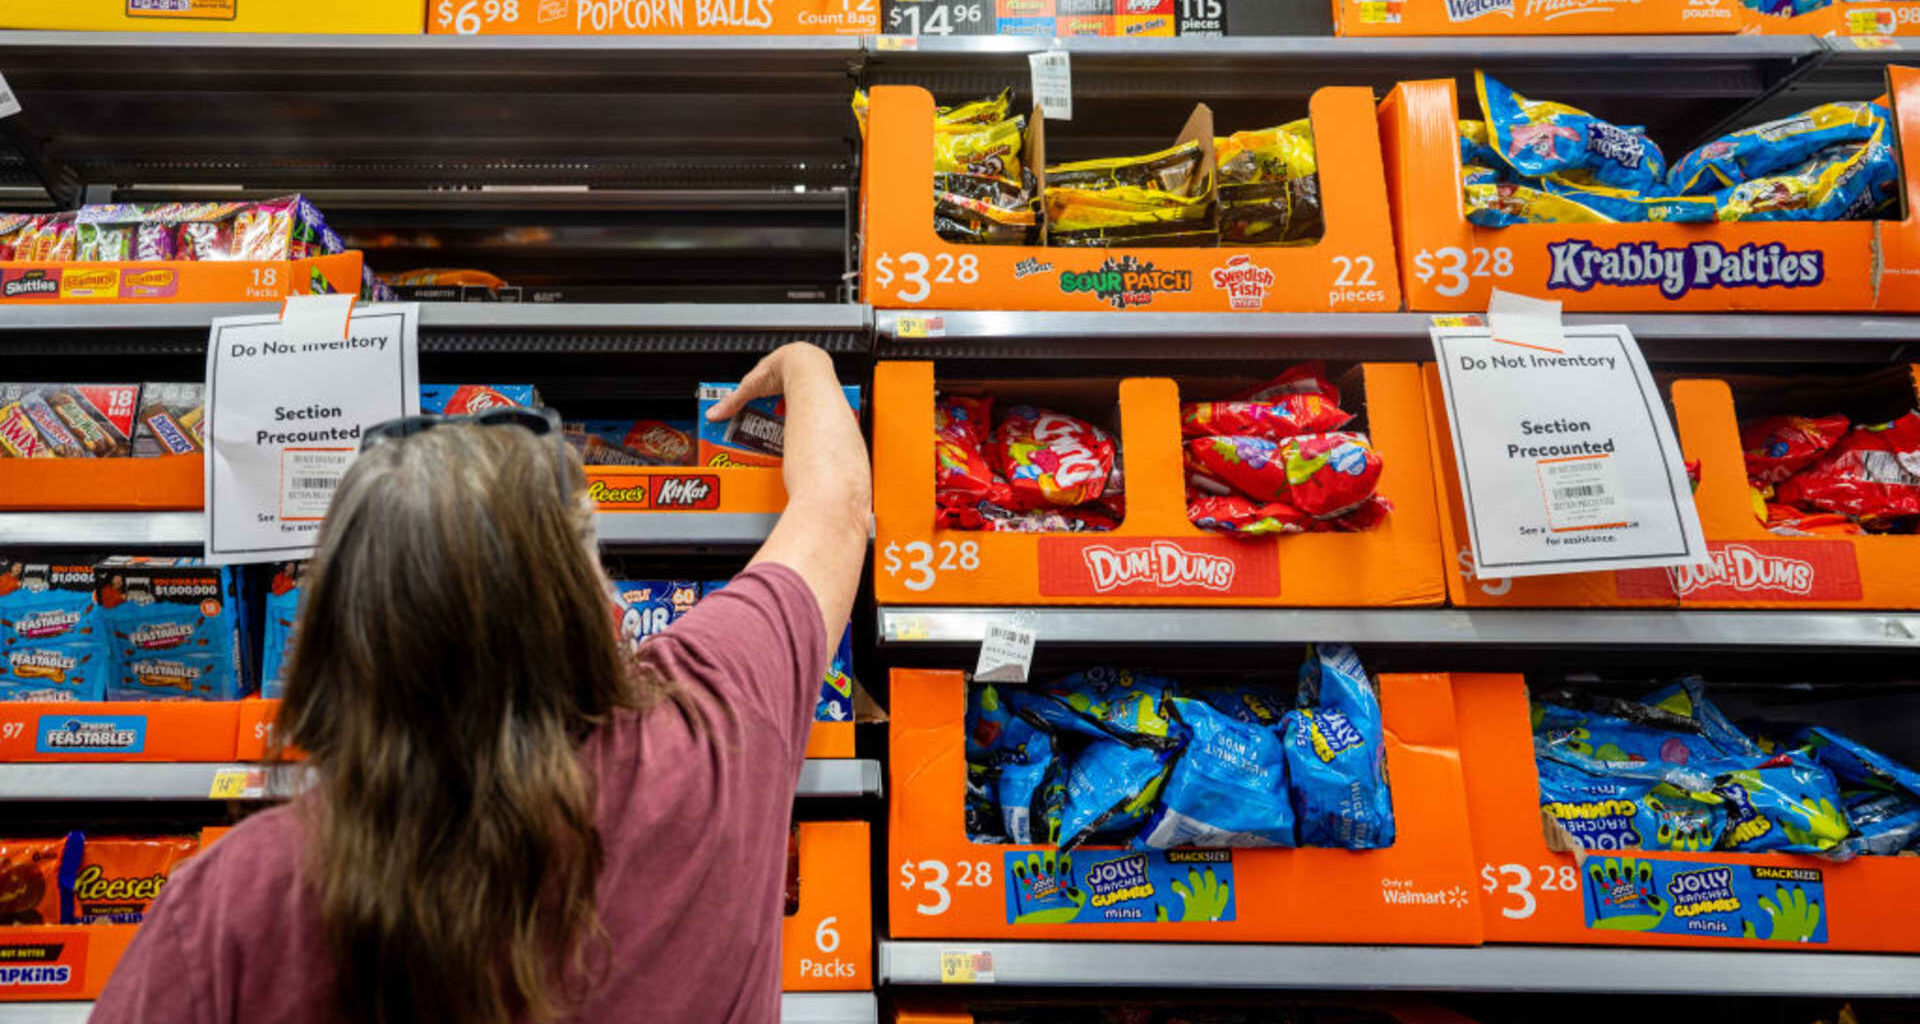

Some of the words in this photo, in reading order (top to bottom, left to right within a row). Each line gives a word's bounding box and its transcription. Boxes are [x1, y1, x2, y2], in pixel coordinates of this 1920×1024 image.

[577, 0, 684, 30] POPCORN
[696, 0, 773, 27] BALLS
[797, 11, 843, 25] Count
[847, 11, 877, 27] Bag
[1682, 7, 1732, 20] pouches
[1181, 19, 1220, 32] pieces
[252, 268, 276, 286] 18
[1212, 264, 1275, 288] Swedish
[1331, 256, 1377, 287] 22
[1549, 242, 1684, 295] Krabby
[1691, 243, 1819, 284] Patties
[5, 280, 57, 295] Skittles
[1059, 271, 1122, 293] SOUR
[1123, 270, 1192, 292] PATCH
[1229, 282, 1263, 298] Fish
[246, 288, 278, 298] Packs
[1329, 287, 1385, 307] pieces
[231, 343, 258, 357] Do
[1460, 356, 1487, 371] Do
[1491, 355, 1527, 369] Not
[1530, 354, 1616, 371] Inventory
[108, 389, 133, 407] 18
[274, 405, 343, 421] Section
[0, 404, 44, 458] TWIX
[149, 414, 194, 453] SNICKERS
[256, 424, 361, 445] Precounted
[1521, 418, 1591, 435] Section
[1507, 438, 1616, 459] Precounted
[257, 513, 275, 522] See
[1519, 526, 1538, 535] See
[1546, 536, 1561, 546] for
[1563, 534, 1617, 545] assistance.
[672, 588, 695, 604] 60
[47, 730, 136, 748] FEASTABLES
[1090, 857, 1146, 883] JOLLY
[74, 866, 167, 899] Reese's
[1096, 875, 1145, 892] RANCHER
[1382, 878, 1402, 889] Only
[1673, 869, 1730, 894] JOLLY
[1091, 883, 1155, 907] GUMMIES
[1382, 889, 1446, 905] Walmart
[1678, 888, 1730, 902] RANCHER
[1105, 907, 1142, 919] minis
[1673, 897, 1741, 917] GUMMIES
[1688, 919, 1728, 932] minis
[815, 916, 840, 953] 6
[800, 958, 856, 978] Packs
